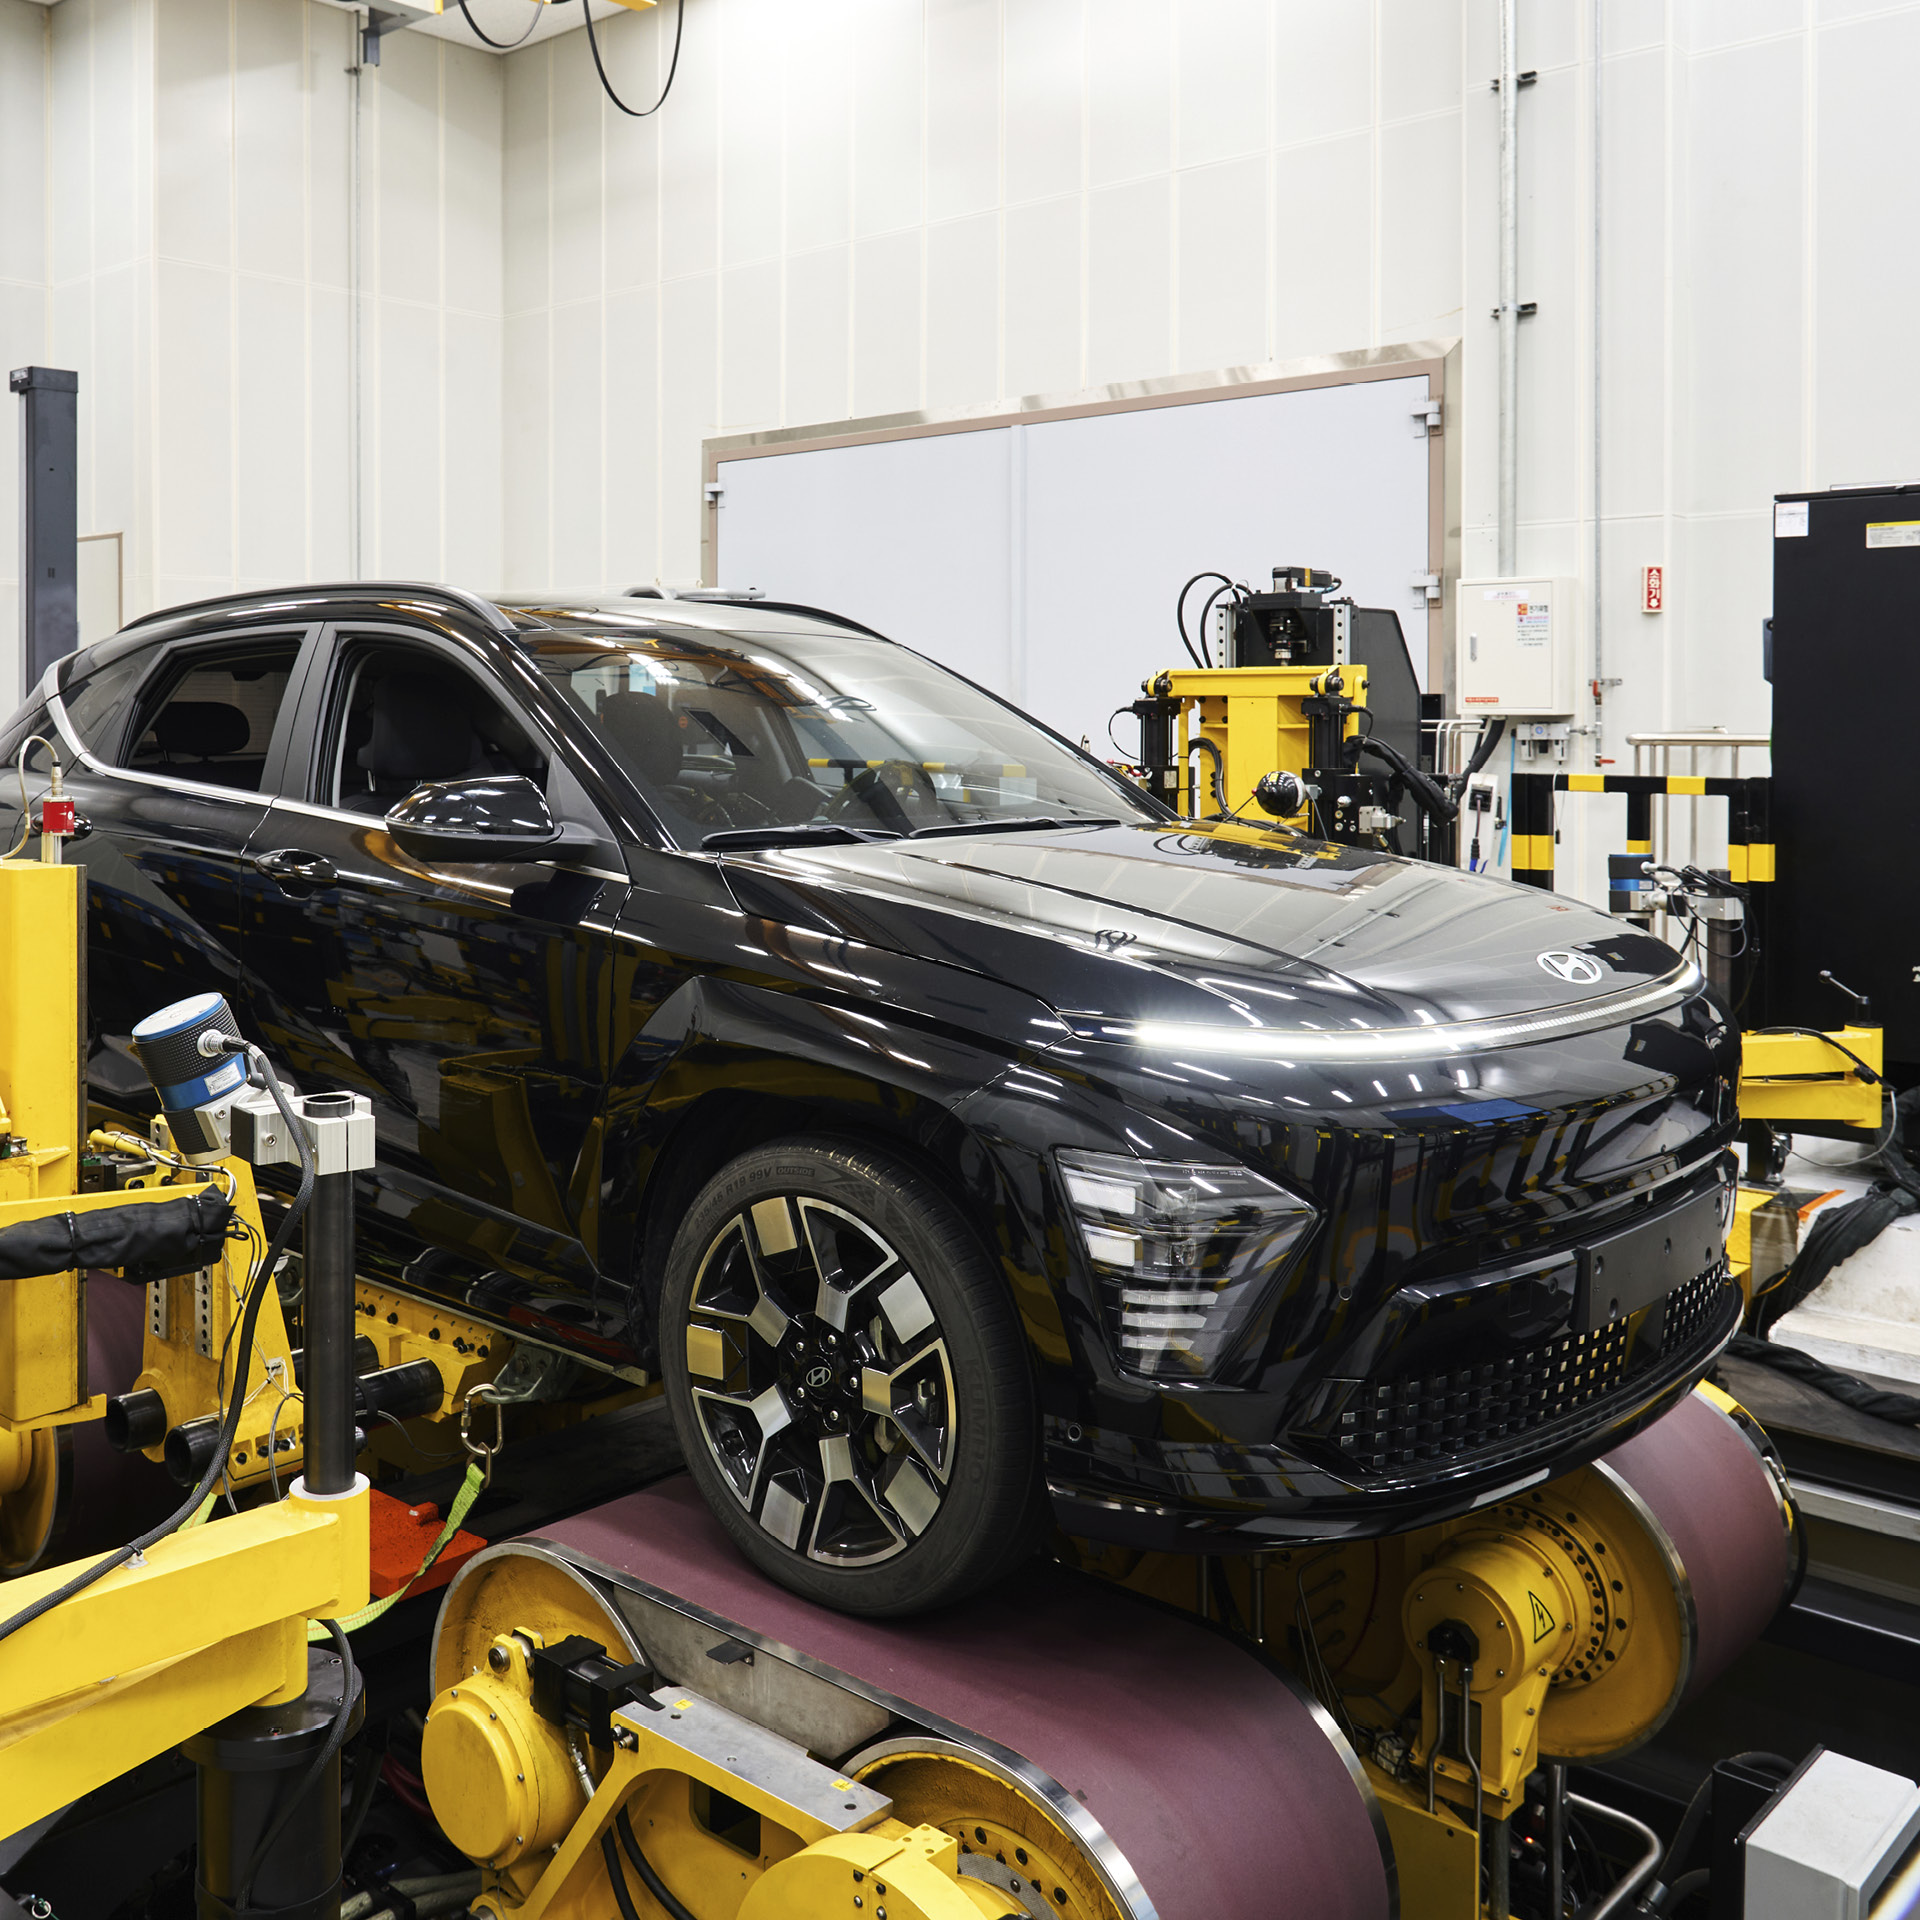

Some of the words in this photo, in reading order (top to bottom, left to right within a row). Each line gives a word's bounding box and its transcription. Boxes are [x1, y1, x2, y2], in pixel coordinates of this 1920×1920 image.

[1649, 569, 1660, 599] 소화기
[725, 1176, 746, 1194] R19
[749, 1167, 772, 1181] 99V
[777, 1166, 814, 1177] OUTSIDE
[965, 1357, 986, 1485] KUMHO
